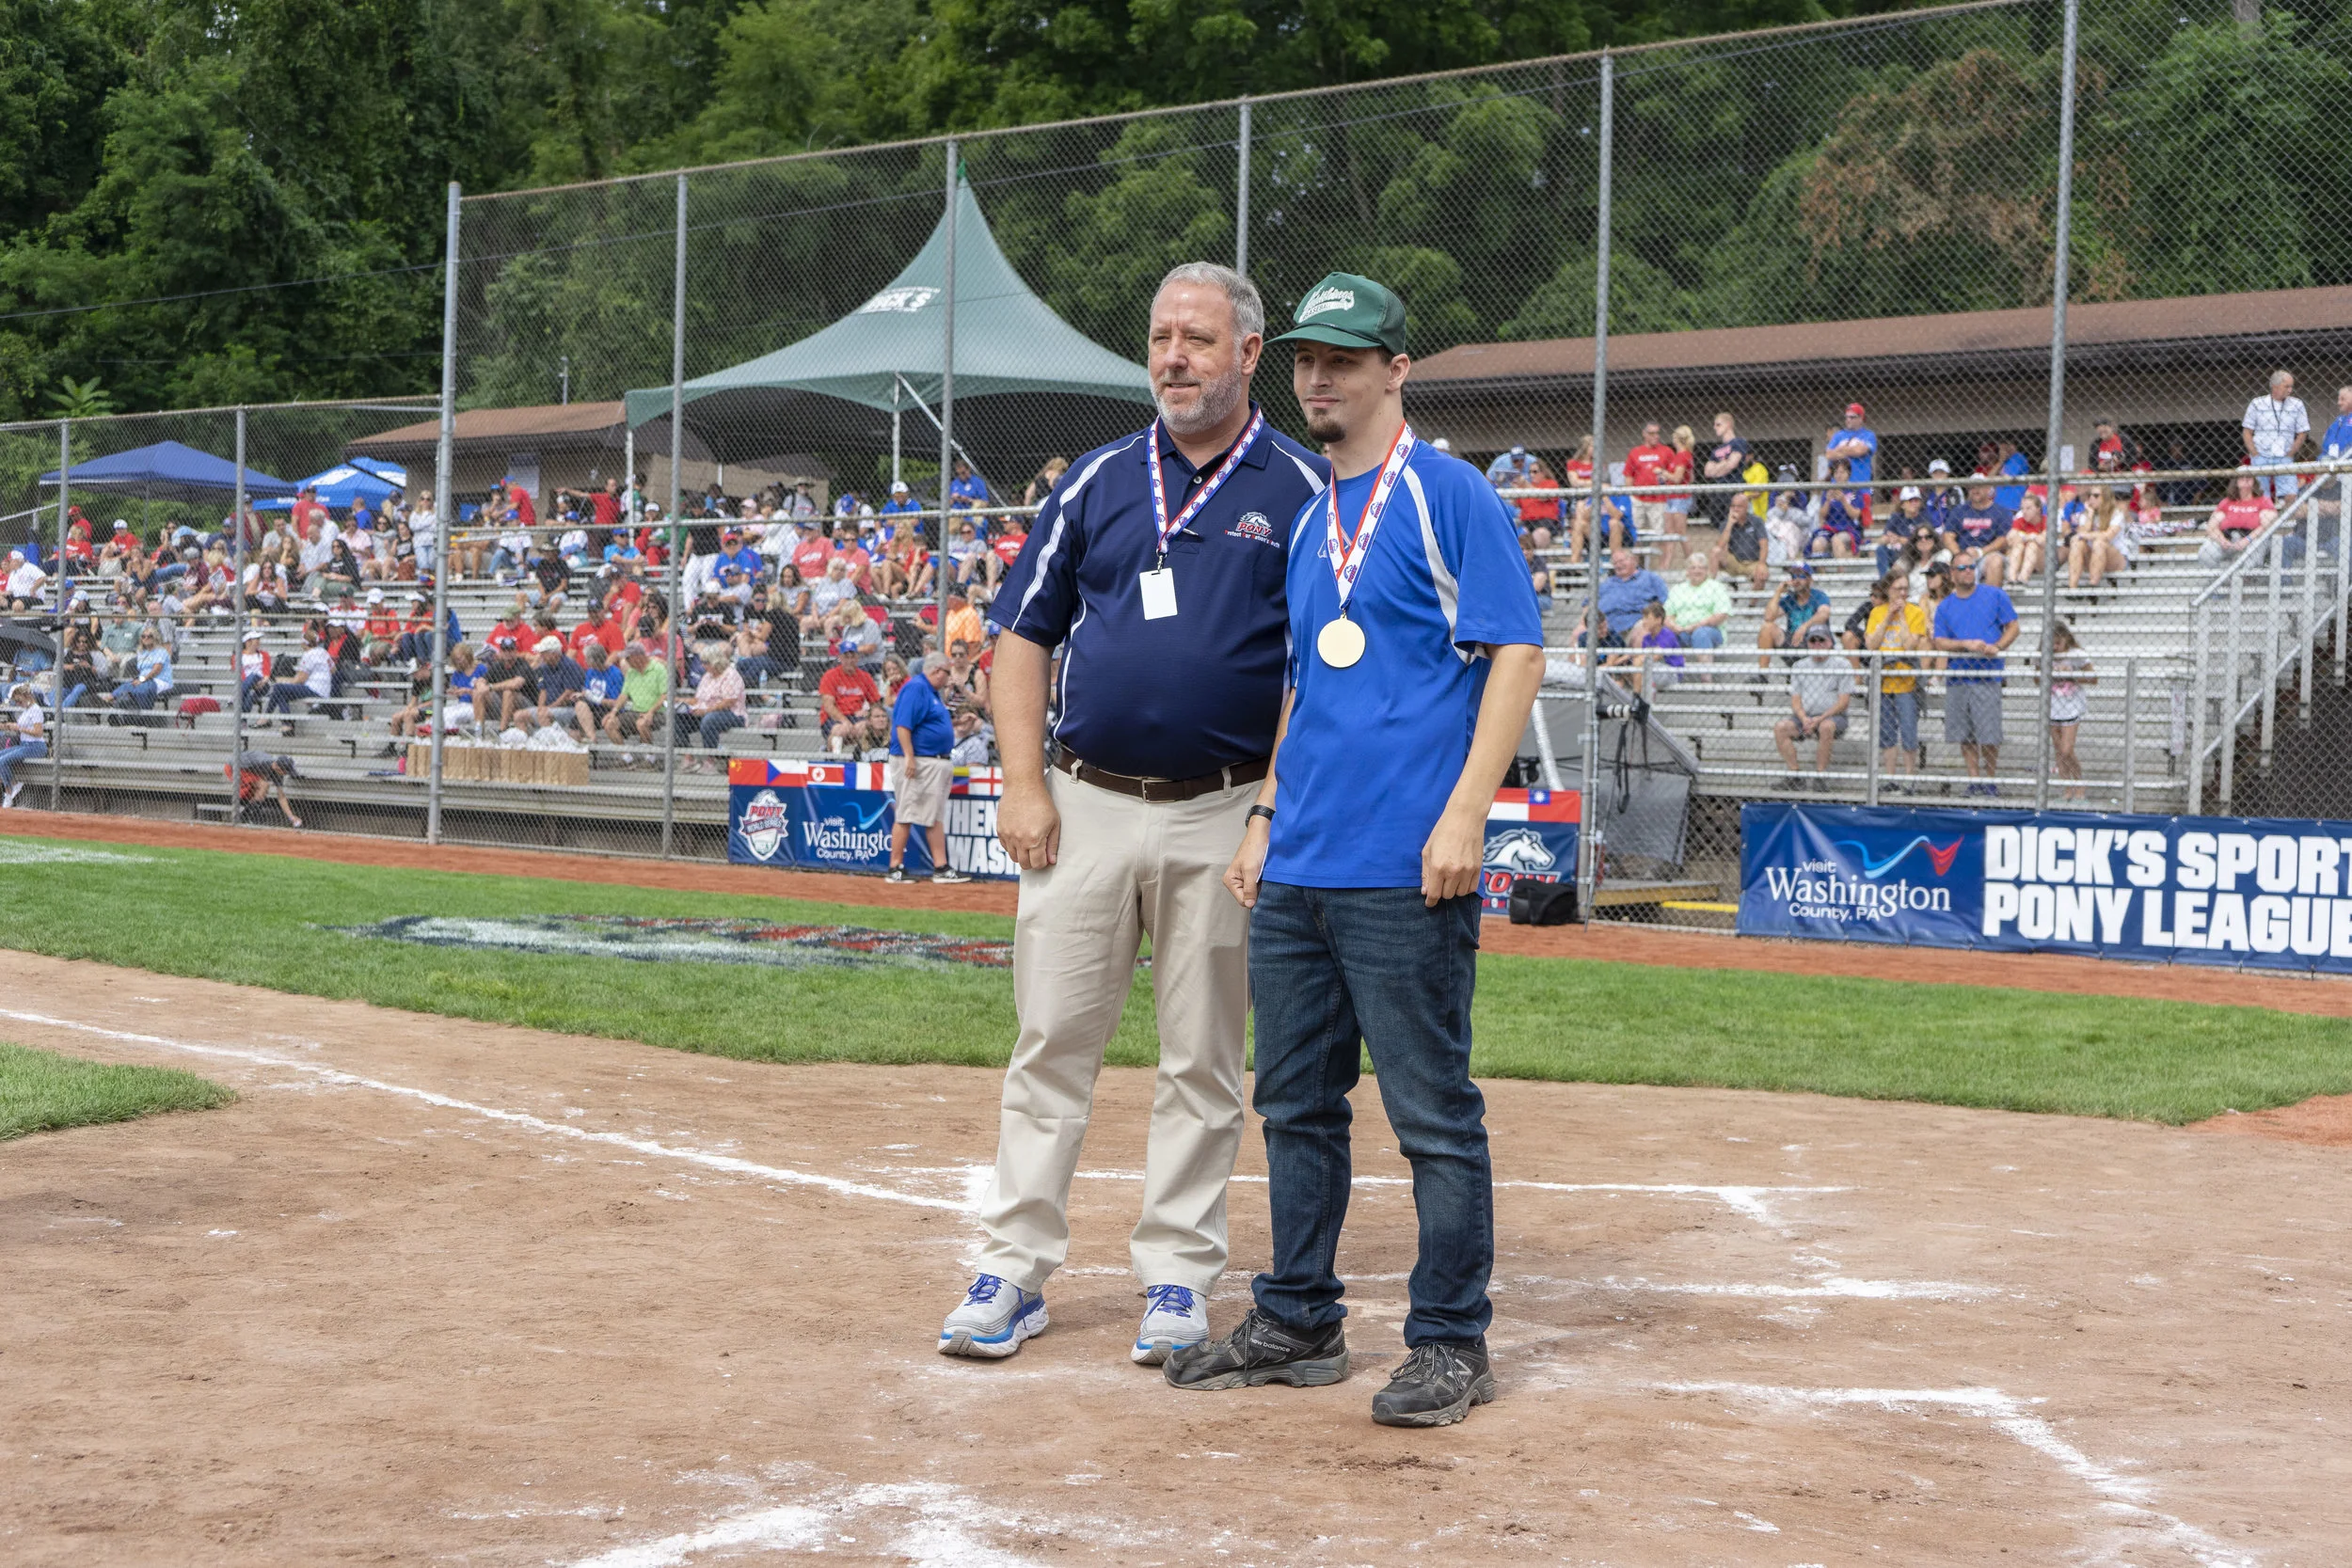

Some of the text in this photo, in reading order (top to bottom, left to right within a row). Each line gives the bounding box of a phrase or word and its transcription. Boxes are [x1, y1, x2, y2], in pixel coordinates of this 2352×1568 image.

[1236, 521, 1272, 537] PONY
[749, 805, 784, 818] PONY
[823, 816, 845, 827] visit
[803, 820, 907, 857] Washingto
[855, 849, 869, 861] PA
[1985, 825, 2167, 887] DICK'S
[1803, 858, 1837, 873] visit
[1765, 866, 1952, 918] Washington
[1856, 907, 1881, 922] PA
[1982, 881, 2133, 944] PONY
[1263, 1340, 1291, 1353] balance
